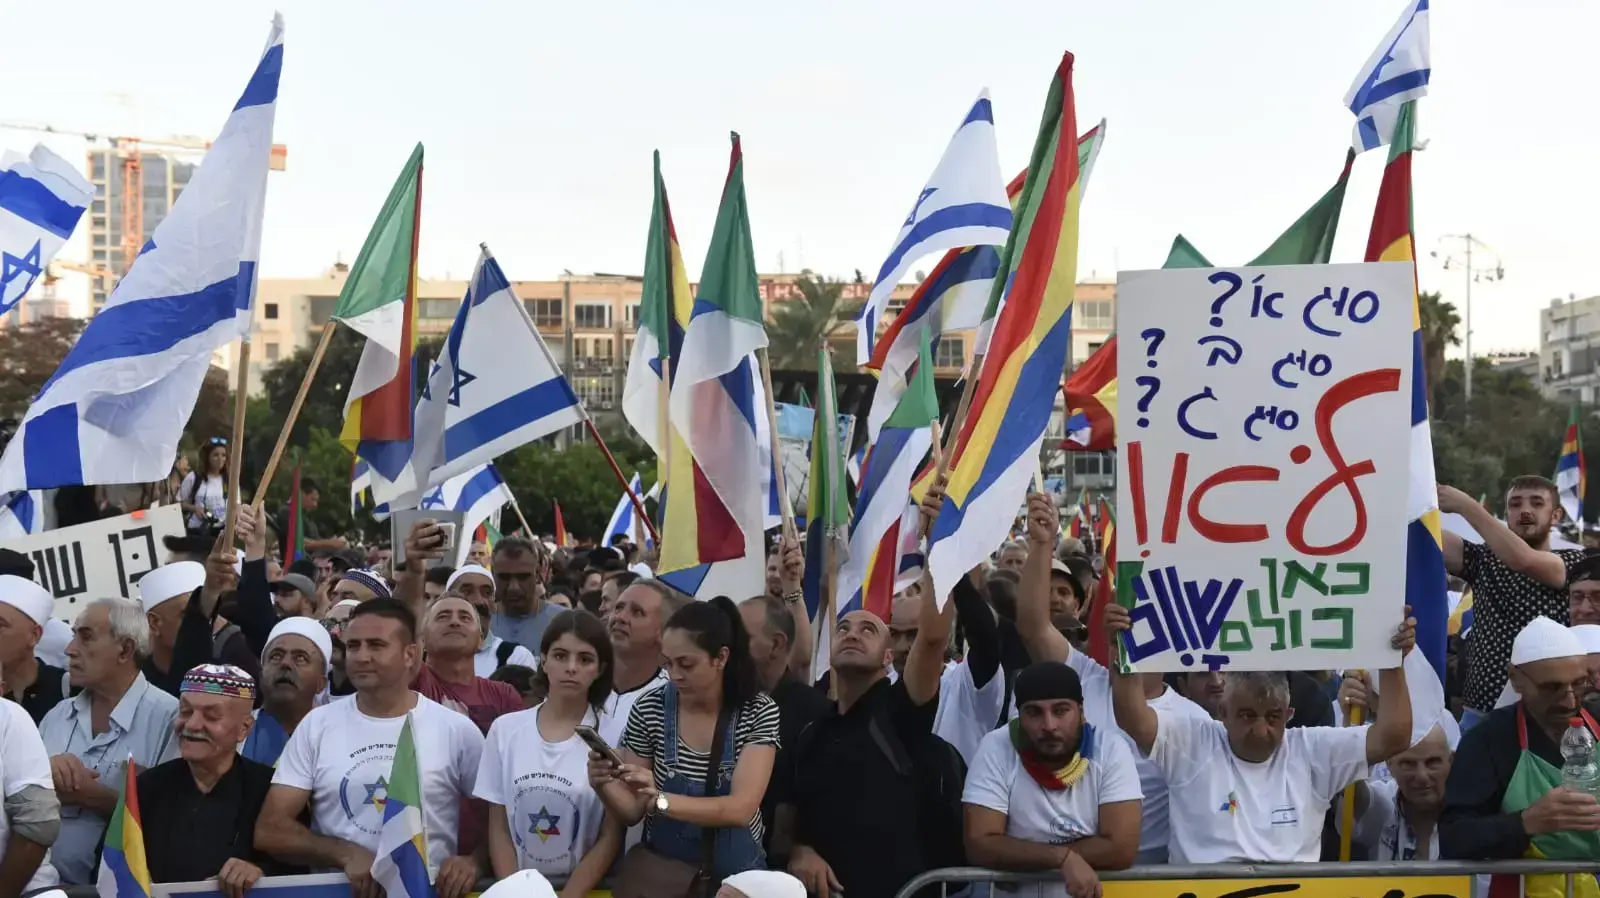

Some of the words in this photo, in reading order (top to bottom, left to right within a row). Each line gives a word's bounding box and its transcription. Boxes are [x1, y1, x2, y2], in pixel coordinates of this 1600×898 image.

[1302, 286, 1380, 337] סוג
[1271, 349, 1333, 389] סוג
[1243, 405, 1300, 442] סוג
[1259, 558, 1371, 615] כאן
[1218, 588, 1354, 652] כולם
